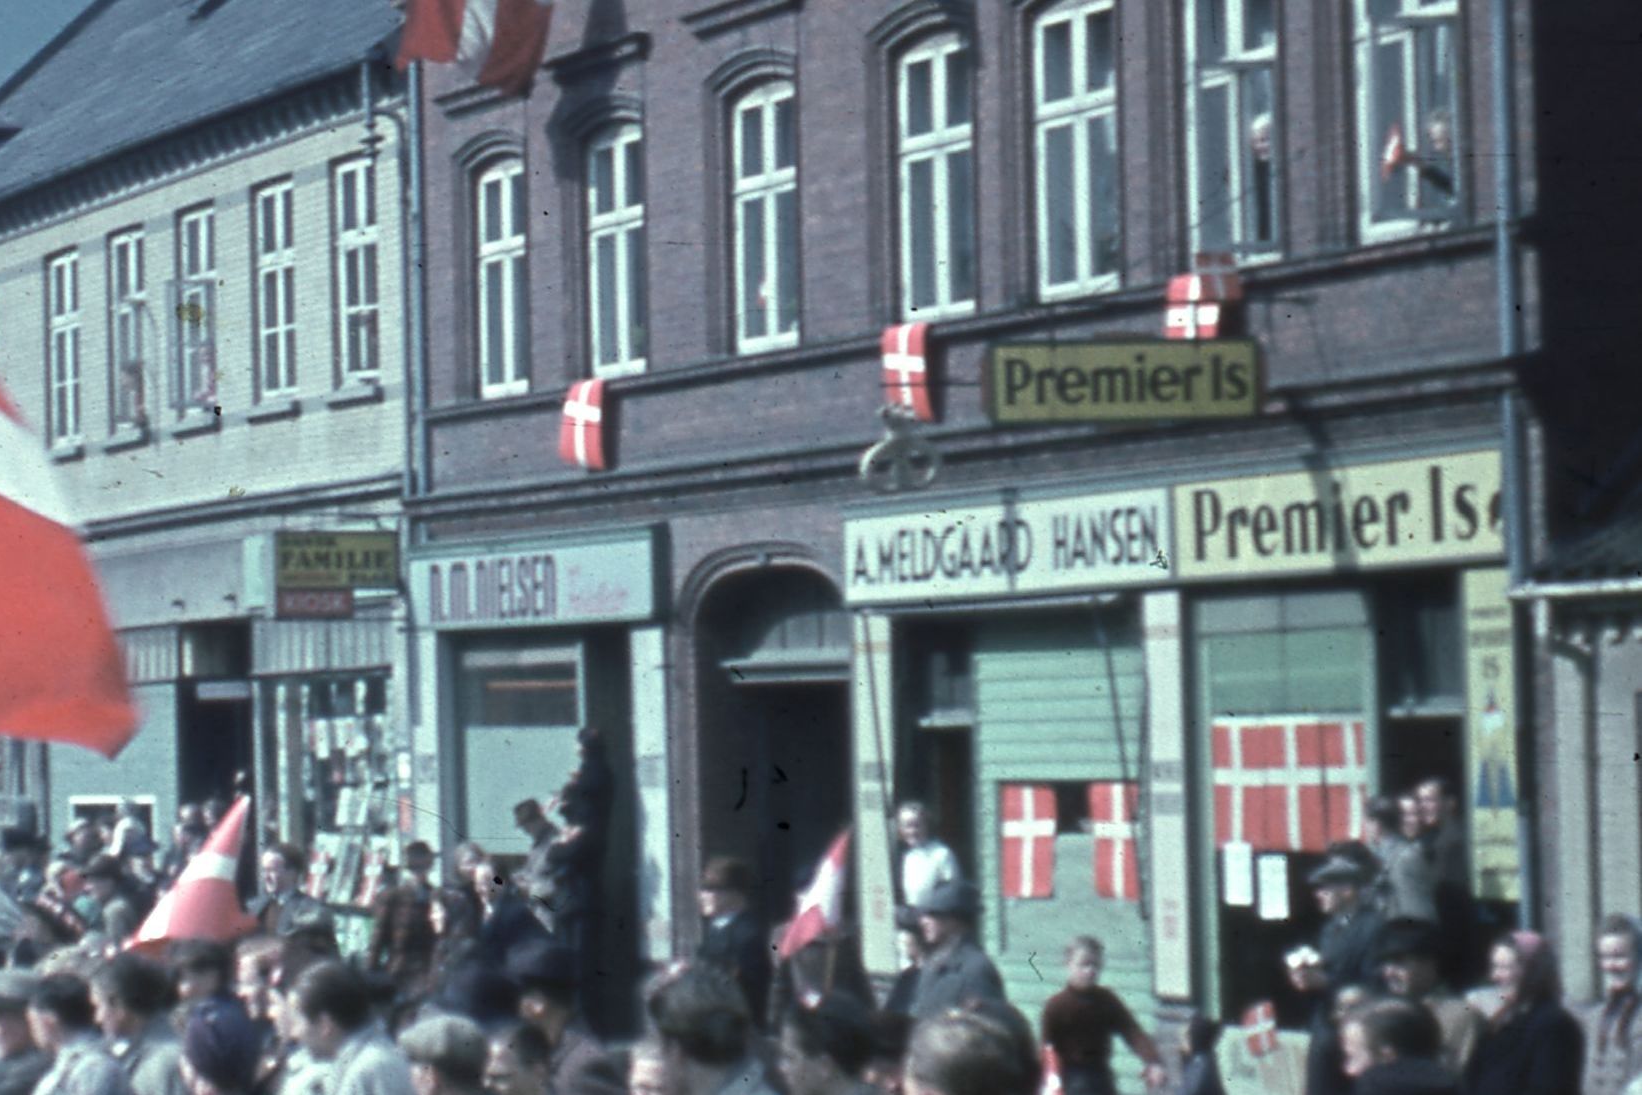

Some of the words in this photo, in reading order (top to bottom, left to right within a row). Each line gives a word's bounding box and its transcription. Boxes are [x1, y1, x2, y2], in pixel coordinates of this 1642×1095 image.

[1003, 352, 1201, 406] Premier
[1210, 354, 1249, 402] Is
[1052, 505, 1160, 572] HANSEN
[1193, 479, 1411, 561] Premier
